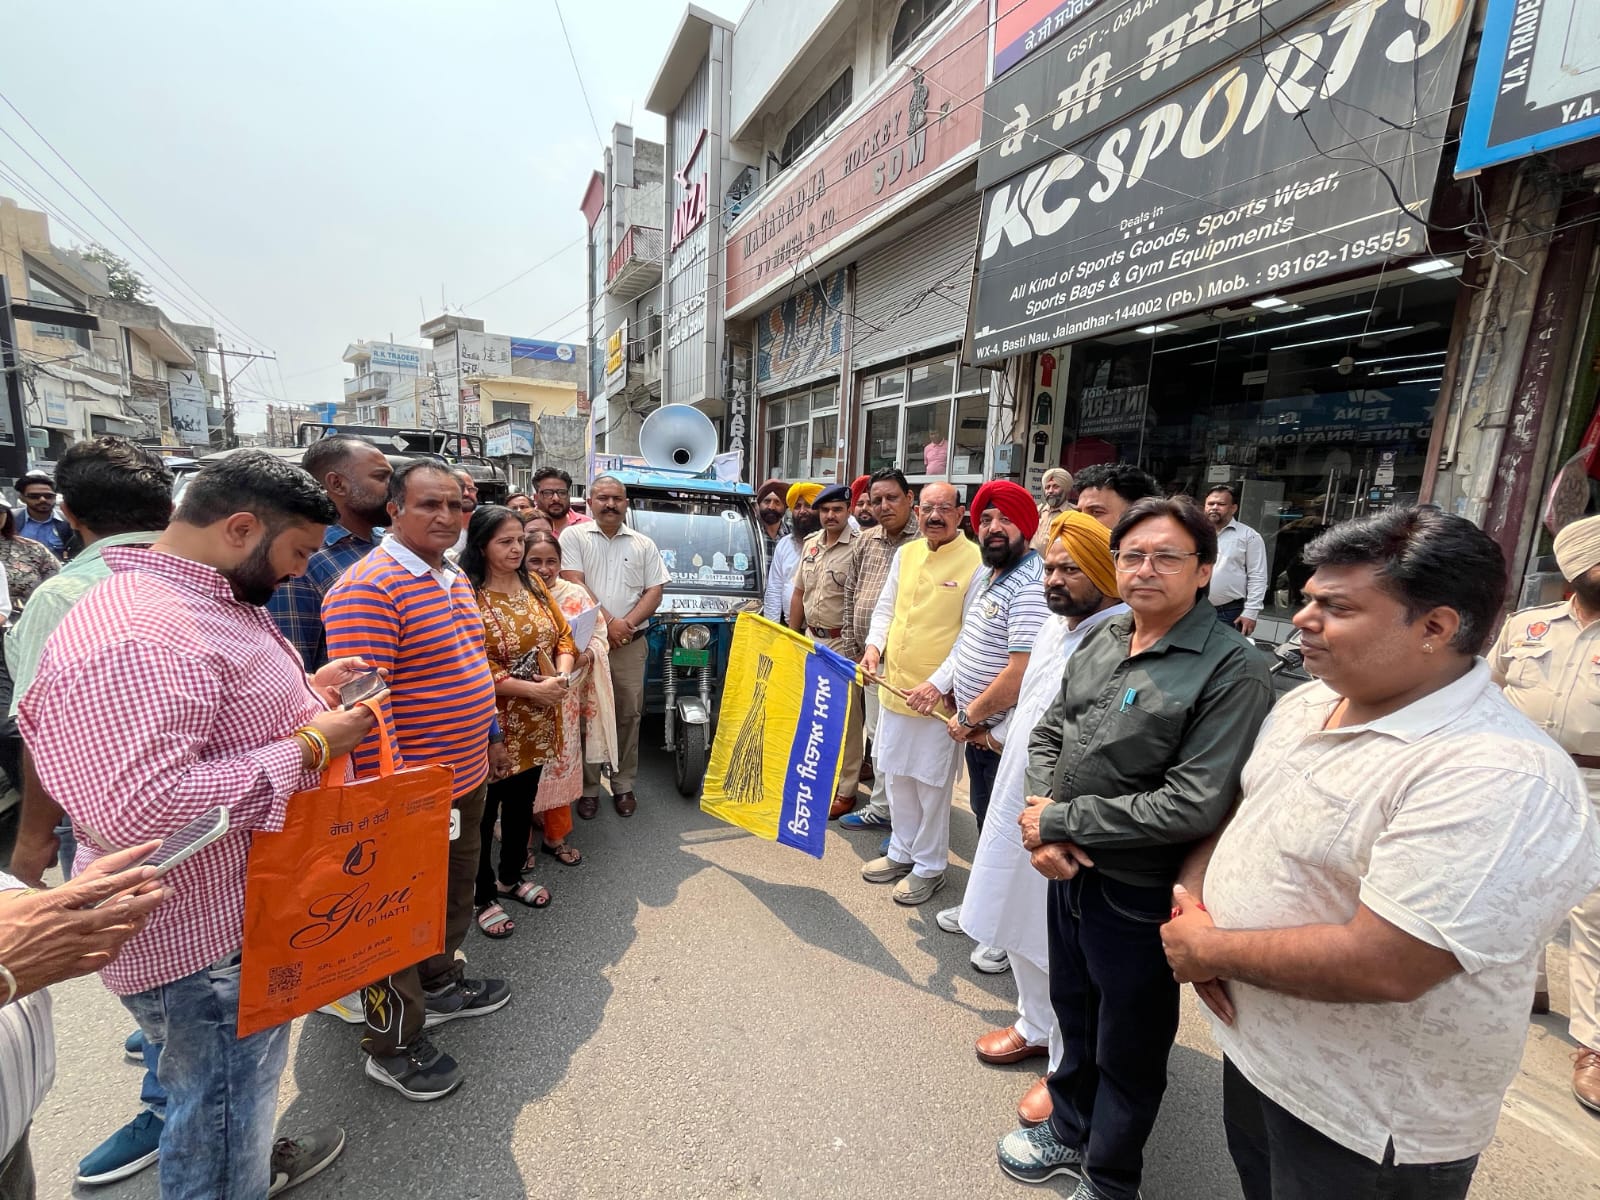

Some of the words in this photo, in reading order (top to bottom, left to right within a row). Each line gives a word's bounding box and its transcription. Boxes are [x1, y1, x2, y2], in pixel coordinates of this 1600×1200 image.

[1067, 31, 1097, 62] GST
[1113, 0, 1159, 33] 03AA
[1500, 57, 1530, 95] Y.A.
[1561, 97, 1600, 124] Y.A.
[743, 168, 826, 260] MAHARADJA
[844, 110, 902, 176] HOCKEY
[981, 154, 1085, 261] KC
[1120, 213, 1150, 232] Deals
[1153, 206, 1164, 219] in
[1010, 283, 1025, 301] All
[1028, 272, 1056, 297] Kind
[1059, 265, 1075, 285] of
[1076, 249, 1125, 281] Sports
[1129, 226, 1190, 260] Goods,
[1196, 198, 1267, 236] Sports
[1274, 171, 1341, 208] Wear,
[1025, 291, 1066, 316] Sports
[1069, 279, 1105, 302] Bags
[1109, 271, 1121, 288] &
[1125, 260, 1165, 284] Gym
[1168, 215, 1295, 269] Equipments
[976, 343, 1000, 360] WX-4,
[1002, 334, 1026, 353] Basti
[1028, 330, 1051, 347] Nau,
[1052, 296, 1162, 339] Jalandhar-144002
[1166, 286, 1202, 312] (Pb.)
[1267, 227, 1412, 282] 93162-19555
[729, 378, 747, 454] MAHARA
[367, 917, 377, 928] DI
[380, 905, 409, 921] HATTI
